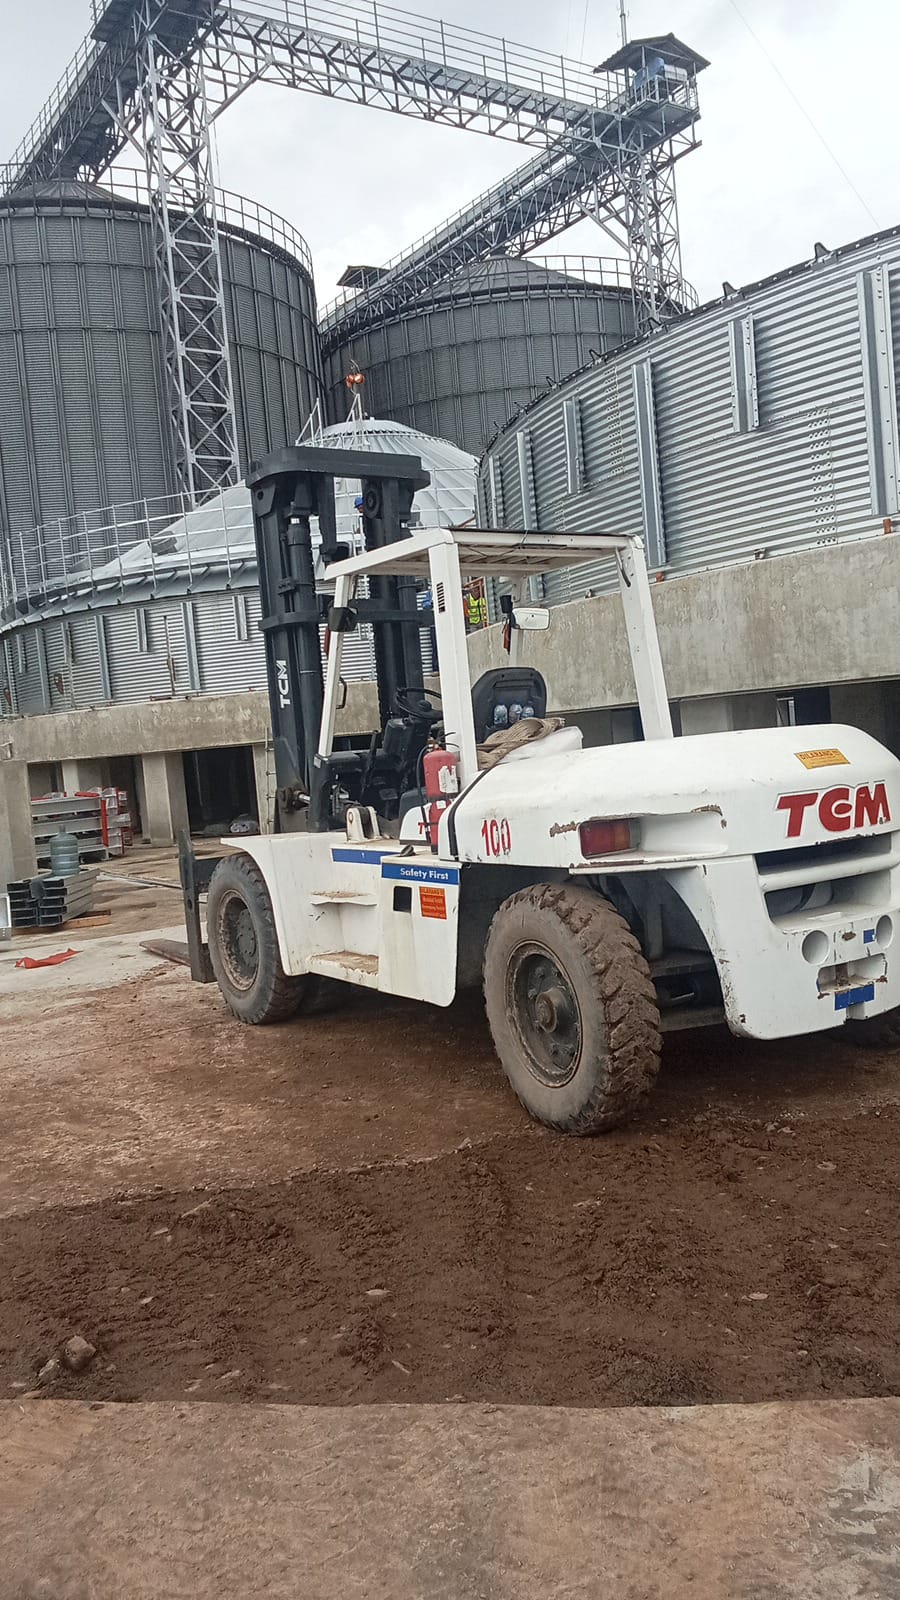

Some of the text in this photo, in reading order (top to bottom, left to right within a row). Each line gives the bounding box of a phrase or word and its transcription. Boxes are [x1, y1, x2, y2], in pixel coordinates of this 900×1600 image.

[276, 660, 290, 708] TCM
[777, 783, 890, 837] TCM
[481, 818, 511, 857] 100
[400, 868, 449, 880] Safety First
